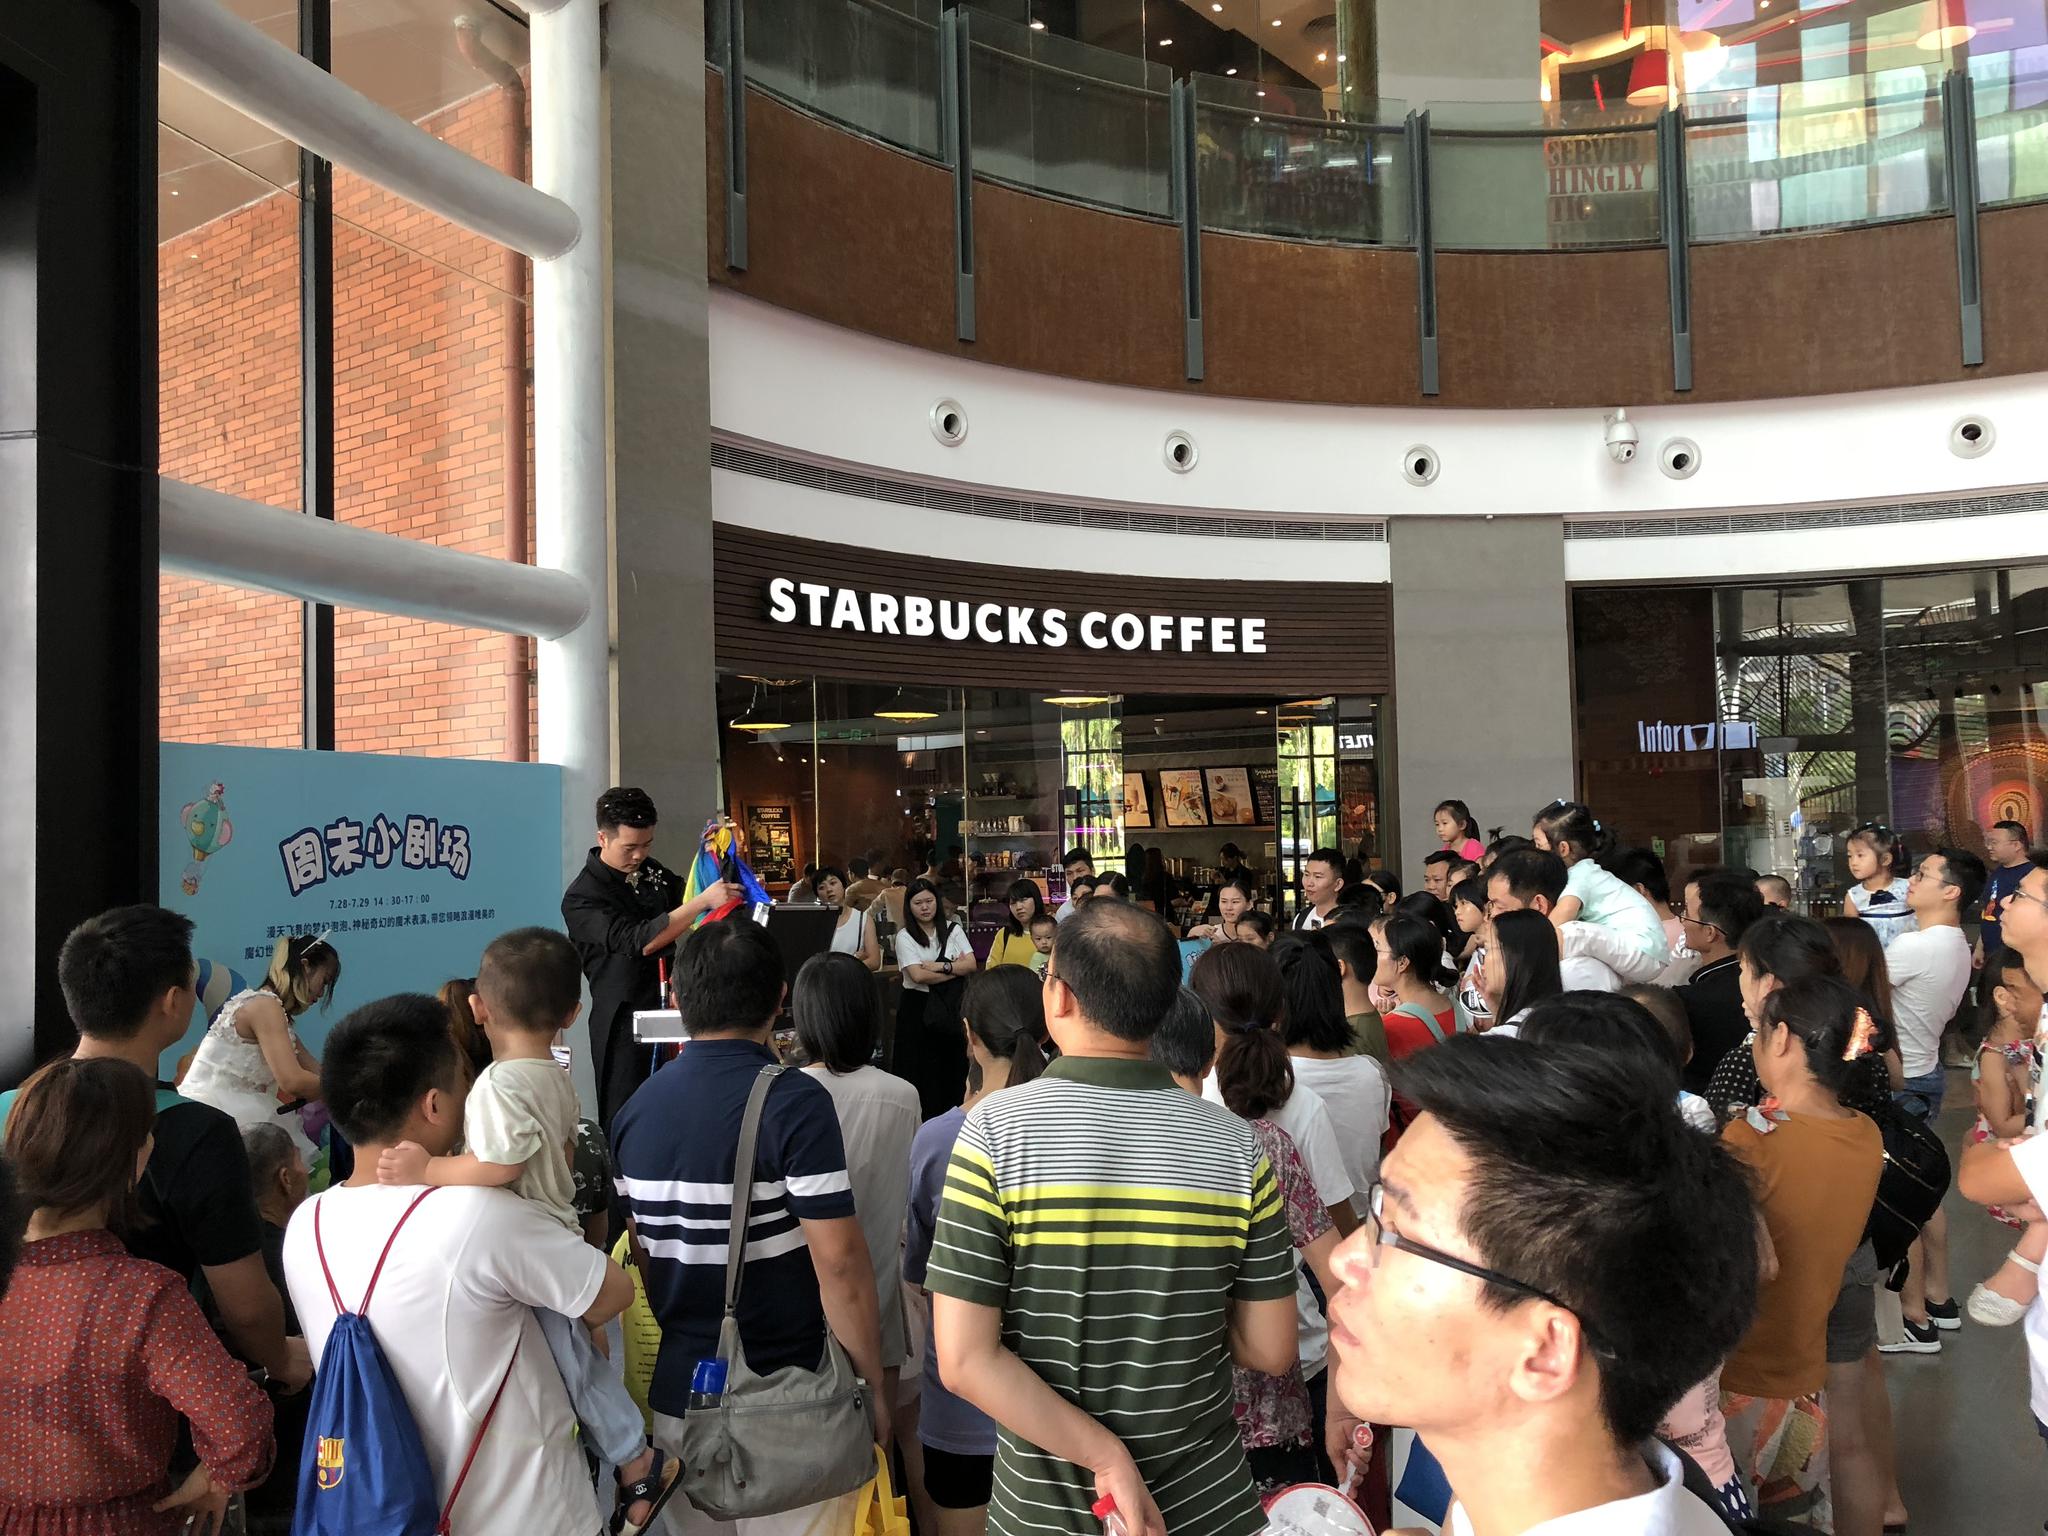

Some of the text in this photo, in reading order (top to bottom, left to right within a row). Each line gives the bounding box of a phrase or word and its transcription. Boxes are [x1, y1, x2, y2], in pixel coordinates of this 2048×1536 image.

[769, 577, 1267, 653] STARBUCKS COFFEE
[281, 815, 470, 895] 周末小剧场
[329, 897, 369, 909] 7.28-7.29
